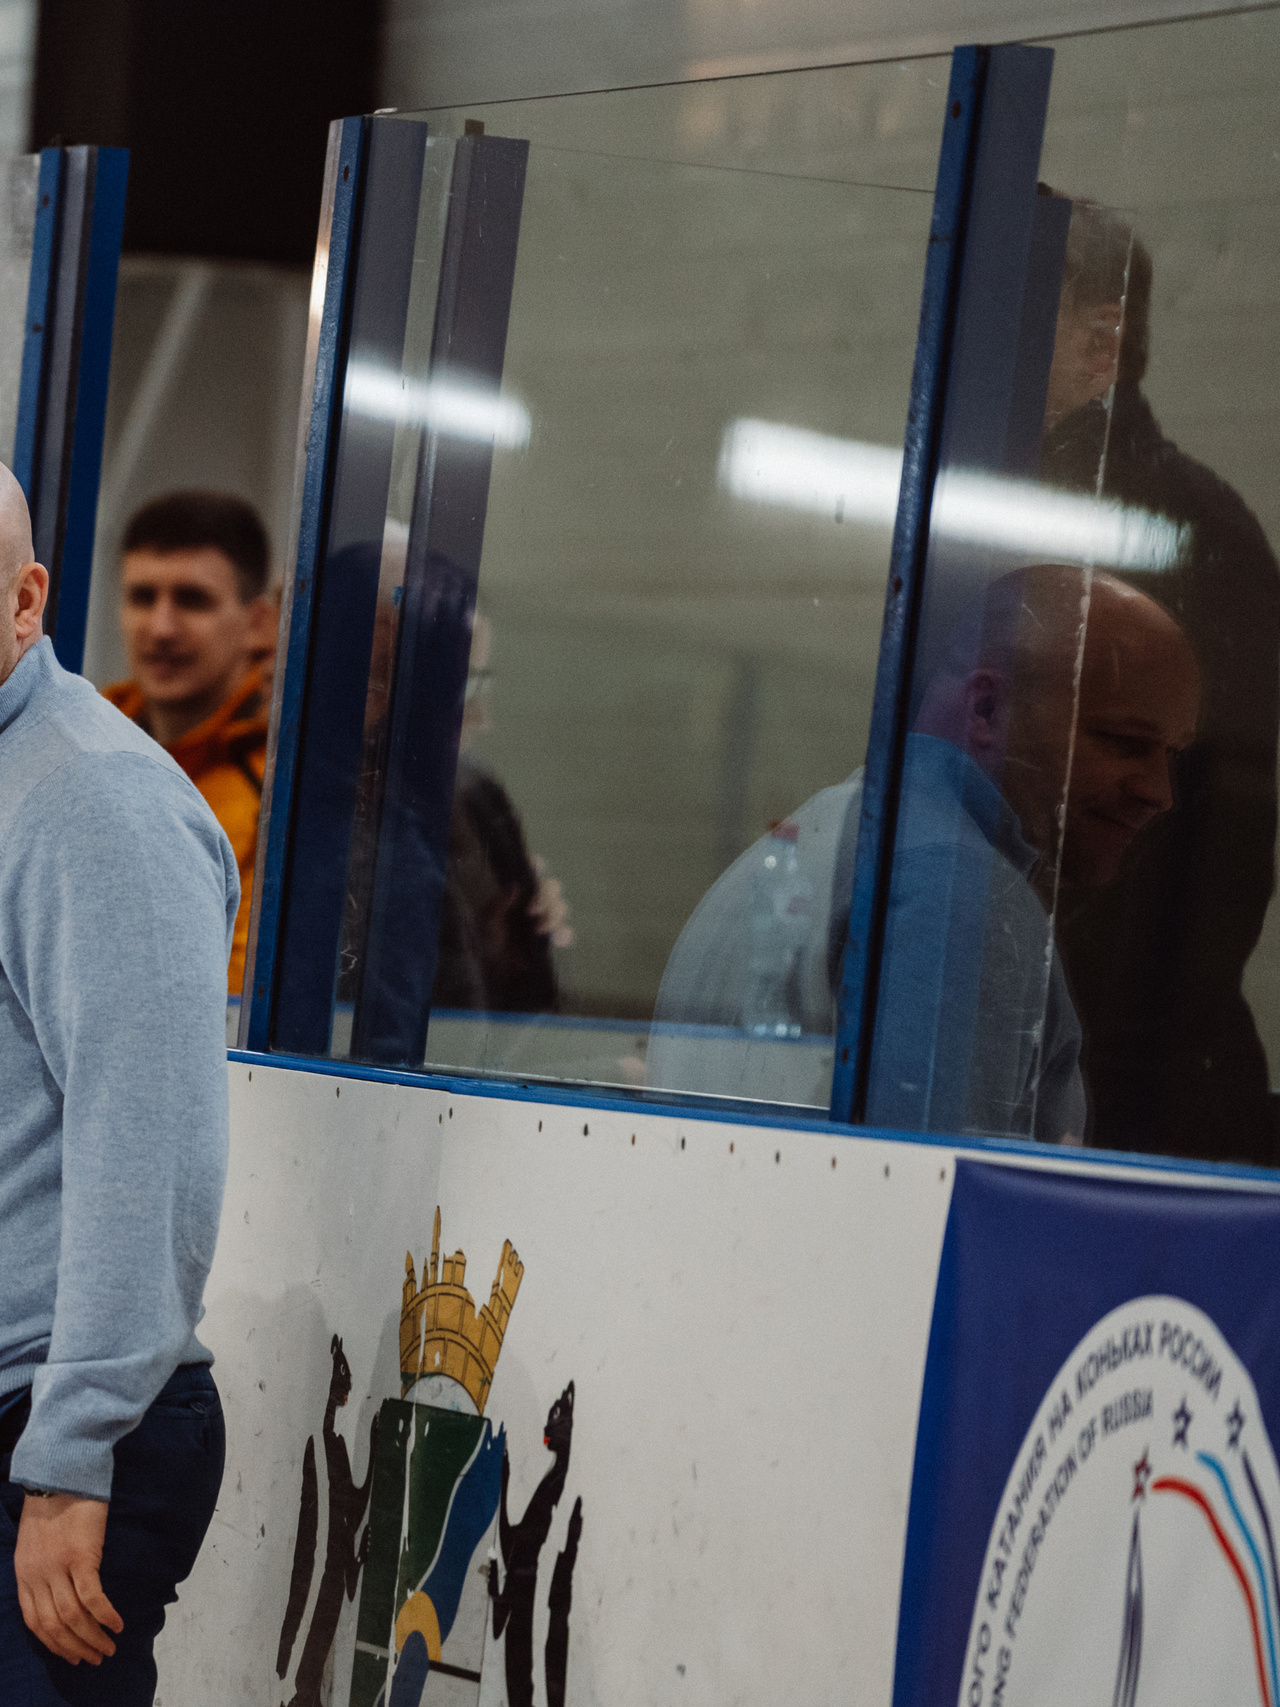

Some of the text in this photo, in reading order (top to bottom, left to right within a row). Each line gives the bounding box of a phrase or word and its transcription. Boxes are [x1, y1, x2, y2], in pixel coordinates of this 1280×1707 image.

[986, 1433, 1047, 1611] КАТАНИЯ
[1047, 1389, 1074, 1443] НА
[1074, 1319, 1154, 1400] КОНЬКАХ
[1157, 1319, 1224, 1402] РОССИИ
[1004, 1447, 1077, 1640] FEDERATION
[1074, 1415, 1098, 1463] OF
[1100, 1386, 1154, 1438] RUSSIA
